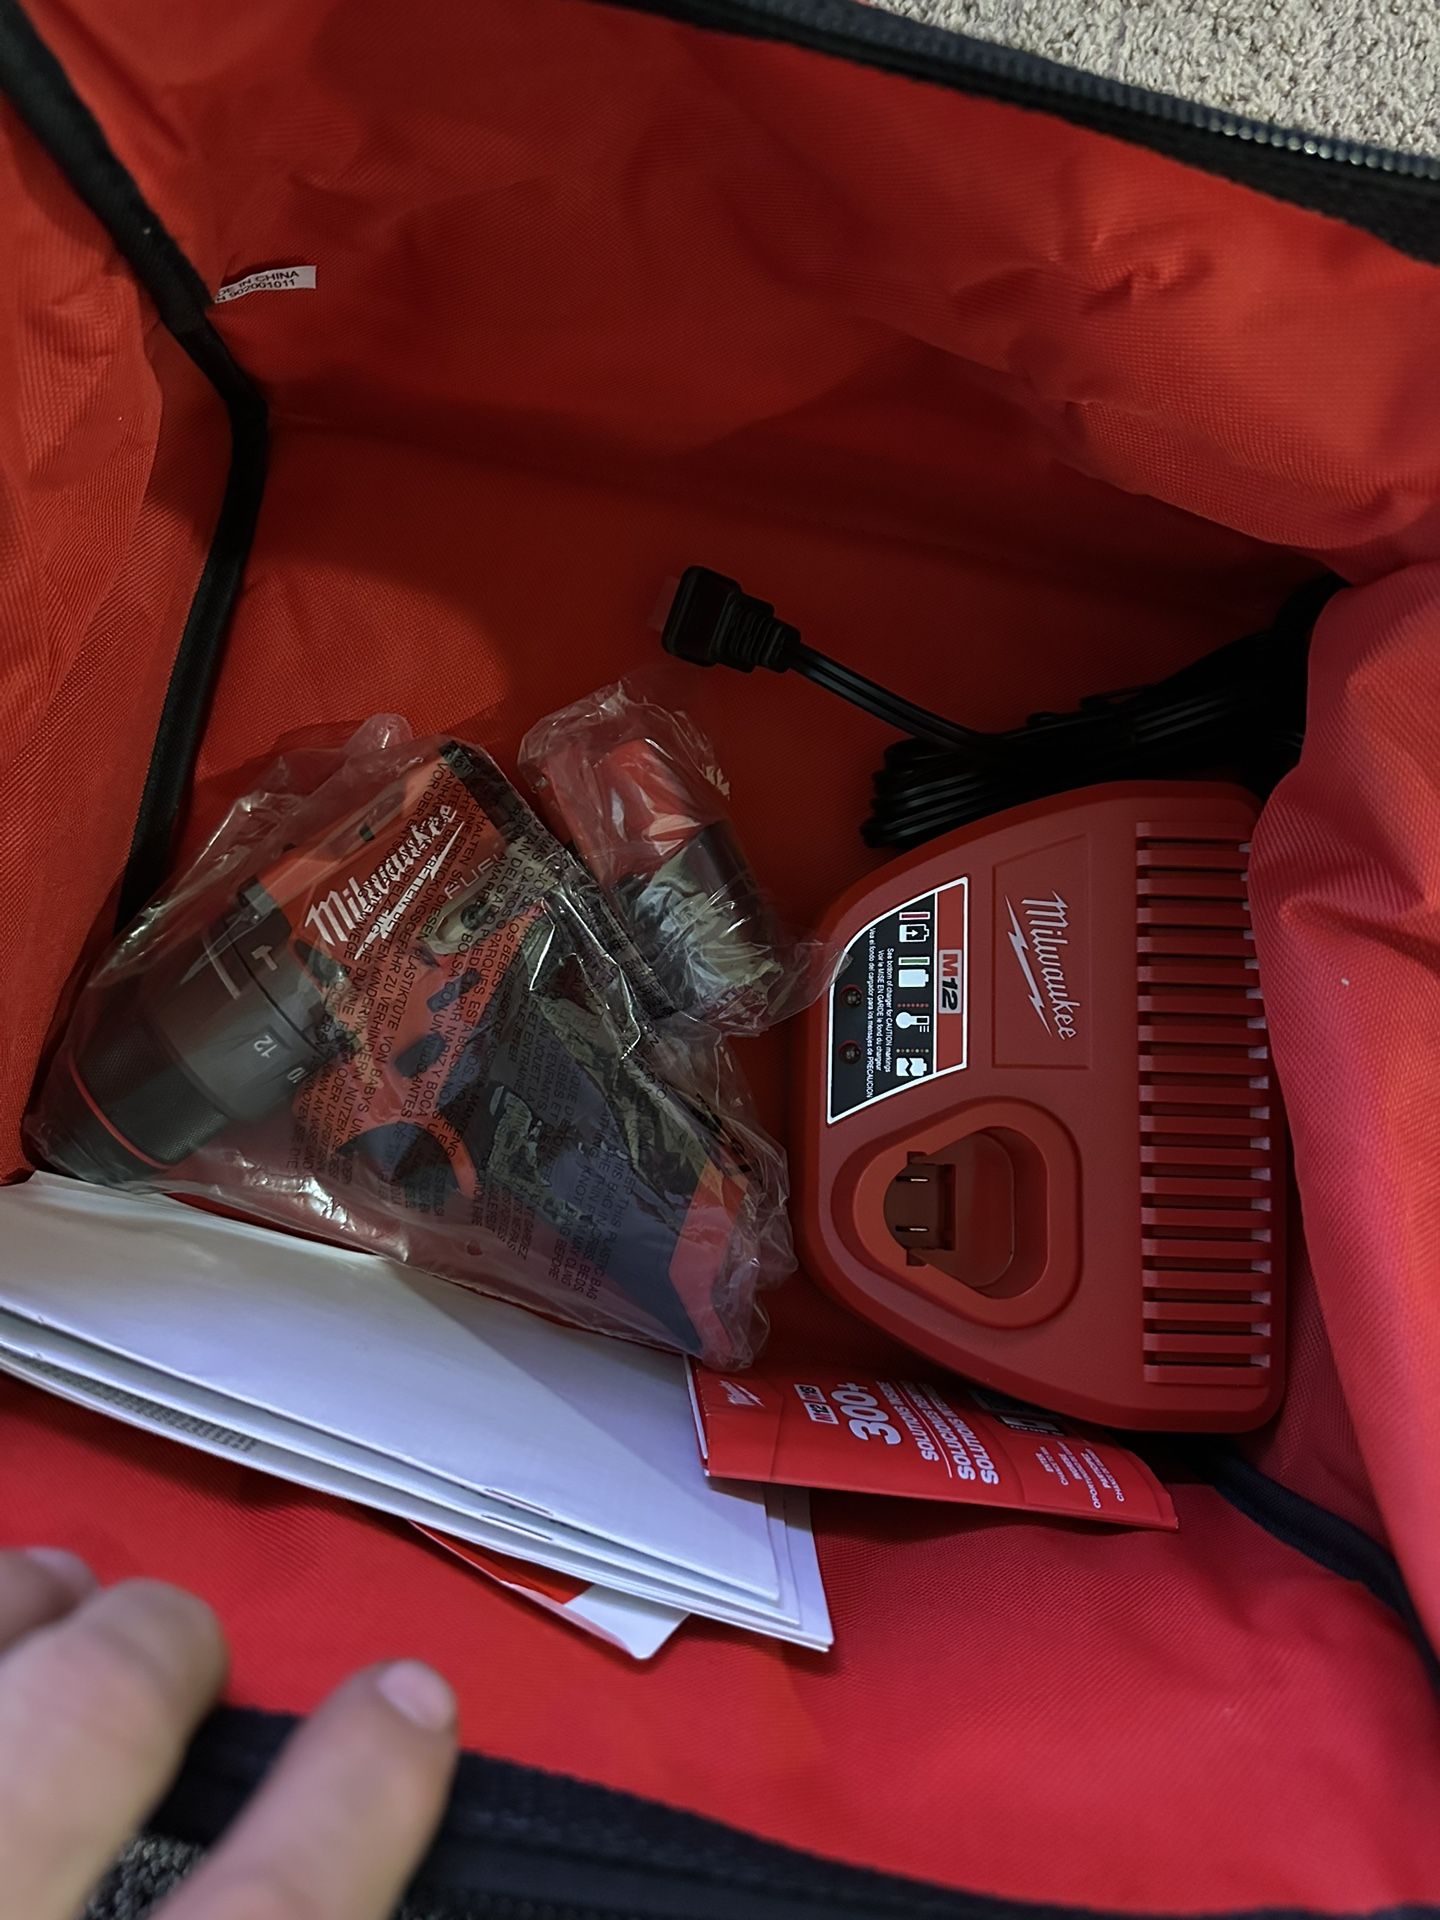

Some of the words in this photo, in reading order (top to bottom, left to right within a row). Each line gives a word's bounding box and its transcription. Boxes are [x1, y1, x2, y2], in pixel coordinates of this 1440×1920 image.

[255, 270, 299, 282] CHINA
[426, 760, 448, 790] VOR
[411, 790, 434, 818] DER
[460, 802, 481, 834] EINE
[458, 815, 490, 866] HALTEN
[516, 833, 541, 856] TAN
[304, 806, 457, 947] Milwaukee
[482, 856, 522, 926] DELGADO
[387, 834, 467, 974] ERSTICKUNGSGEFAHR
[499, 865, 536, 919] CARROS
[415, 893, 448, 943] DIESEN
[504, 915, 524, 942] LOS
[358, 942, 375, 964] DIE
[447, 932, 474, 980] BOLSA
[886, 948, 894, 959] See
[1021, 890, 1081, 1041] Milwaukee
[382, 974, 397, 993] ZU
[886, 960, 894, 979] bottom
[941, 953, 959, 1011] M12
[436, 981, 456, 1011] CON
[877, 984, 883, 993] EN
[884, 986, 893, 1008] charger
[429, 1012, 445, 1034] UN
[460, 999, 481, 1035] ESTA
[477, 1002, 496, 1030] LOS
[536, 1017, 551, 1037] UN
[254, 1034, 278, 1058] 12
[375, 1033, 394, 1063] VON
[434, 1025, 457, 1067] NARIZ
[865, 1020, 873, 1046] mensajes
[415, 1033, 437, 1074] NUDO
[445, 1035, 469, 1079] BOLSA
[874, 1045, 882, 1070] chargeur
[883, 1046, 891, 1072] markings
[315, 1060, 334, 1095] KANN
[328, 1066, 349, 1103] ODER
[356, 1067, 382, 1114] BABYS
[437, 1080, 453, 1101] NO
[311, 1095, 324, 1114] AN
[334, 1086, 358, 1135] NUTZEN
[399, 1074, 423, 1119] ANTES
[415, 1080, 438, 1119] BOCA
[547, 1101, 562, 1120] ET
[285, 1145, 300, 1171] DIE
[572, 1164, 594, 1203] KNOT
[600, 1181, 618, 1210] BAG
[558, 1206, 578, 1237] BAG
[610, 1197, 629, 1228] THIS
[546, 1238, 568, 1279] BEFORE
[559, 1256, 577, 1286] CLING
[572, 1263, 591, 1293] BEDS
[585, 1276, 602, 1300] BAG
[831, 1382, 901, 1445] 300+
[894, 1405, 939, 1461] SOLUTIONS
[923, 1408, 976, 1481] SOLUCIONES
[948, 1417, 999, 1485] SOLUTIONS
